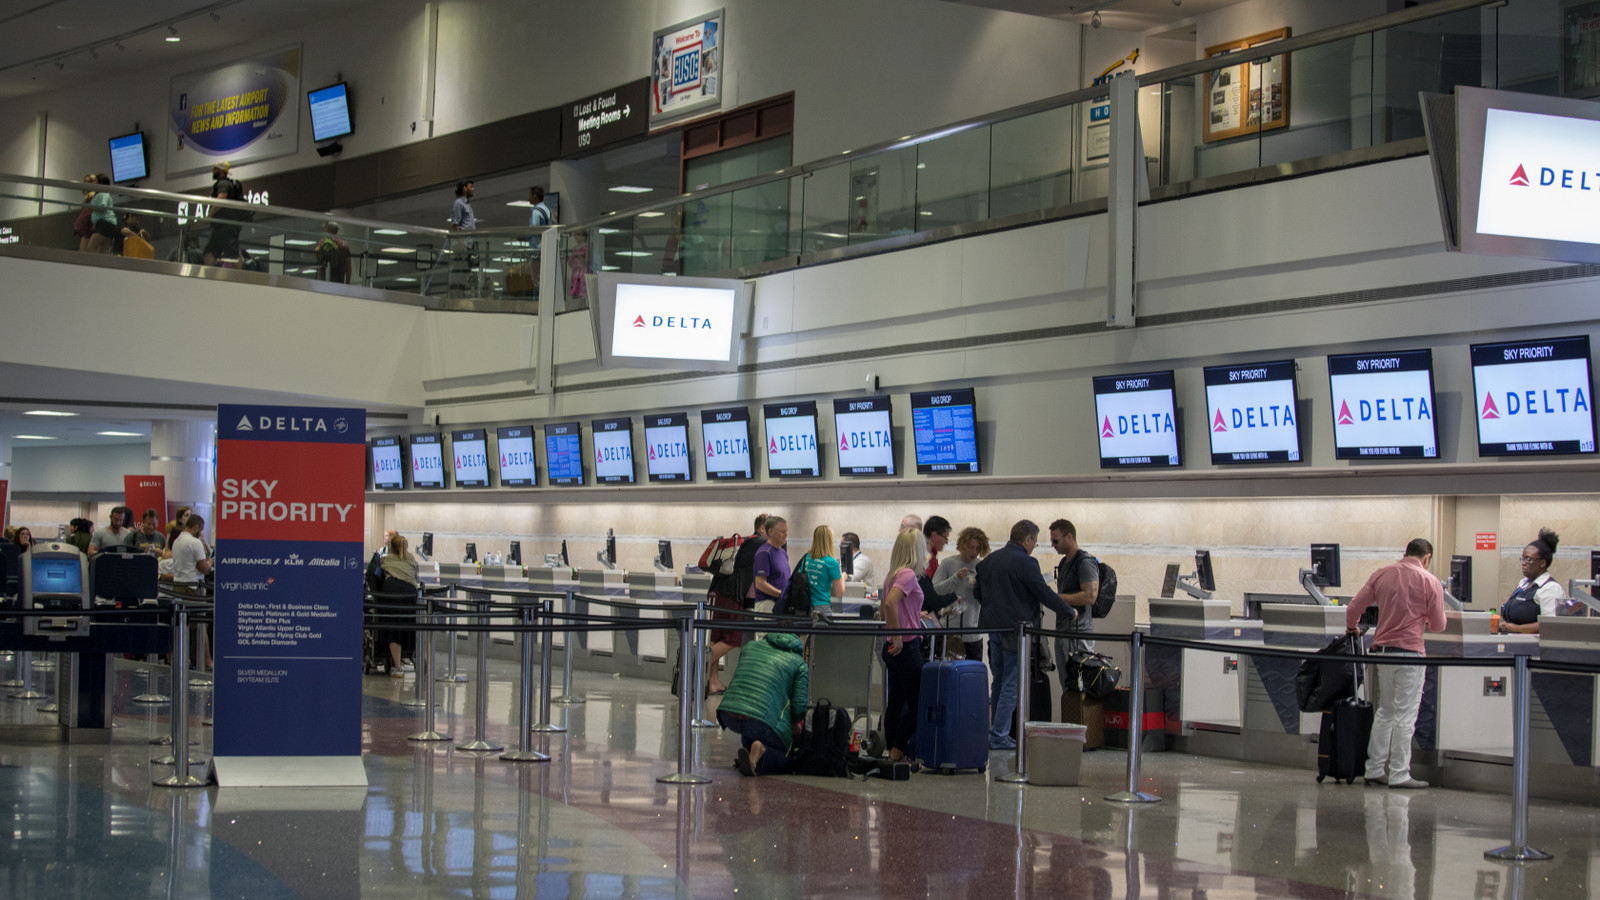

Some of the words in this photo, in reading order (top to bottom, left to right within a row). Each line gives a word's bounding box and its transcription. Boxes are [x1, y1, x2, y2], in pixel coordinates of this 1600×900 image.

[675, 33, 694, 44] Welcome
[677, 54, 695, 83] USO
[190, 103, 202, 118] FOR
[204, 101, 215, 116] THE
[216, 95, 240, 112] LATEST
[240, 88, 268, 107] AIRPORT
[579, 101, 592, 116] Lost
[592, 99, 597, 112] &
[598, 92, 616, 110] Found
[192, 117, 210, 134] NEWS
[210, 115, 224, 130] AND
[224, 104, 270, 128] INFORMATION
[578, 115, 600, 132] Meeting
[601, 109, 621, 125] Rooms
[578, 132, 590, 147] USO
[652, 316, 712, 329] DELTA
[1504, 349, 1518, 360] SKY
[1519, 346, 1553, 359] PRIORITY
[1357, 360, 1370, 370] SKY
[1371, 358, 1400, 370] PRIORITY
[1229, 371, 1240, 381] SKY
[1241, 368, 1267, 380] PRIORITY
[1116, 380, 1126, 390] SKY
[1126, 378, 1150, 389] PRIORITY
[931, 396, 940, 404] BAG
[940, 395, 952, 404] DROP
[1507, 388, 1588, 415] DELTA
[1232, 404, 1294, 428] DELTA
[1360, 397, 1431, 421] DELTA
[260, 416, 327, 432] DELTA
[1118, 412, 1174, 434] DELTA
[716, 438, 748, 454] DELTA
[780, 434, 816, 451] DELTA
[851, 430, 890, 448] DELTA
[1582, 441, 1593, 451] n19
[604, 446, 631, 461] DELTA
[658, 442, 687, 458] DELTA
[380, 458, 400, 471] DELTA
[420, 456, 442, 469] DELTA
[462, 454, 486, 467] DELTA
[508, 452, 534, 465] DELTA
[222, 478, 278, 499] SKY
[222, 501, 352, 522] PRIORITY
[308, 558, 340, 566] Alitalia
[221, 581, 242, 591] virgin
[243, 582, 269, 590] atlantic
